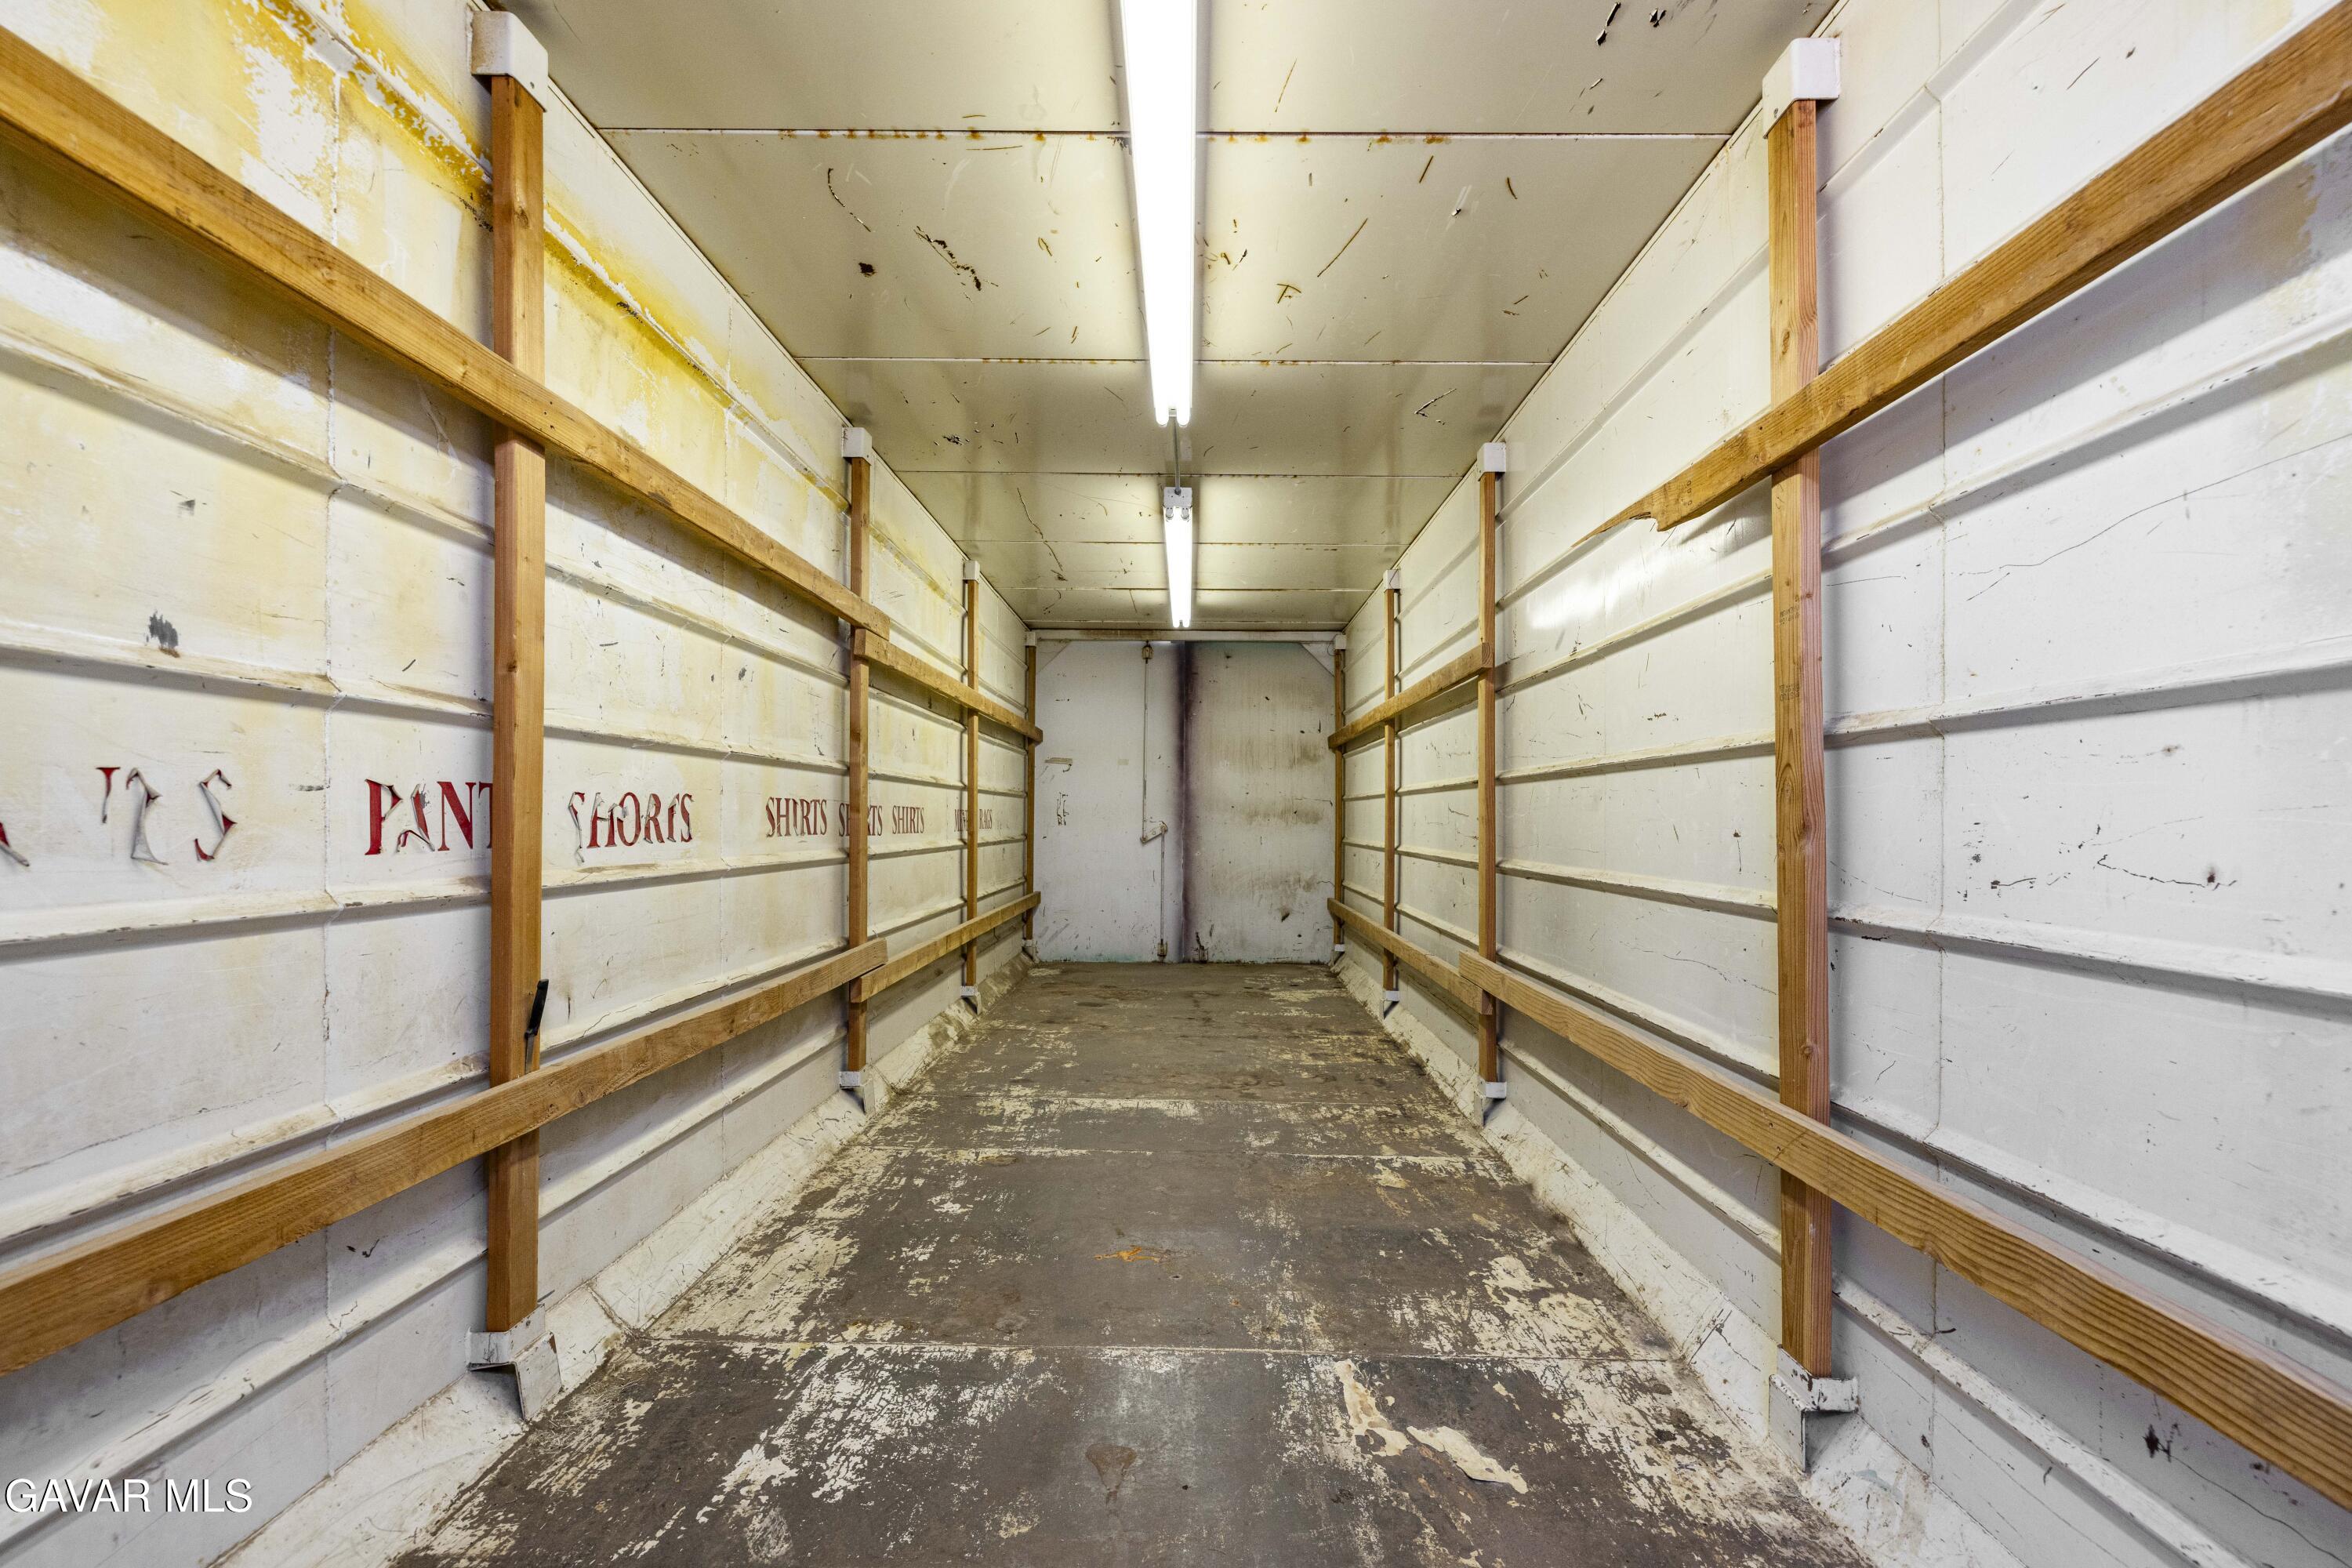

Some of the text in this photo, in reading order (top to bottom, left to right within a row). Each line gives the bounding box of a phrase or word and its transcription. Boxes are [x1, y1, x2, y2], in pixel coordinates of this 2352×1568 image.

[765, 797, 827, 838] SHIRTS
[892, 805, 924, 834] SHIRTS
[979, 809, 993, 829] RAGS
